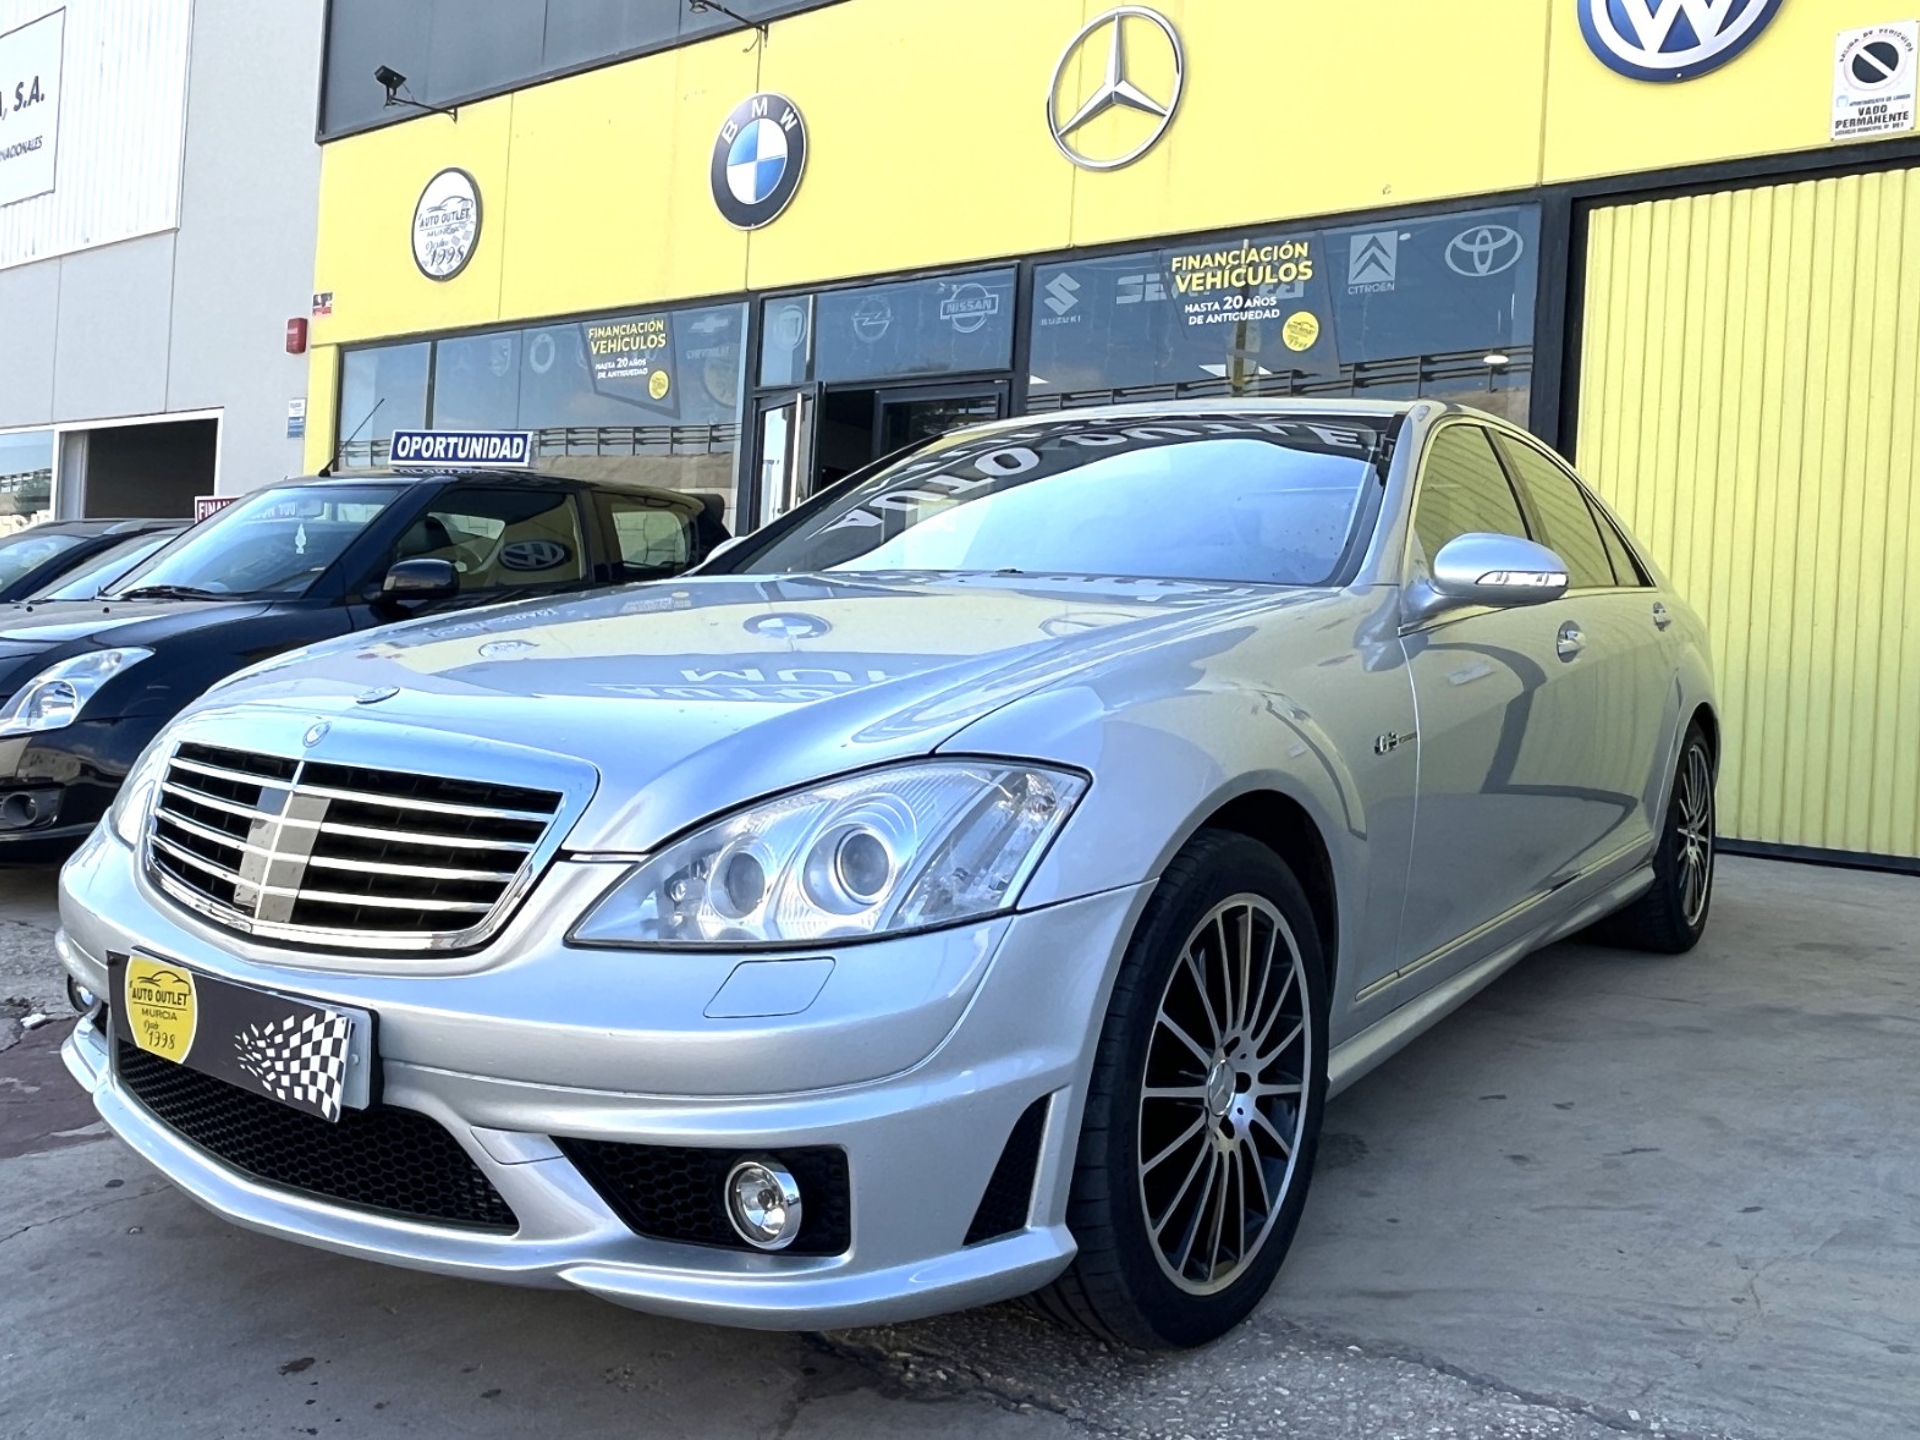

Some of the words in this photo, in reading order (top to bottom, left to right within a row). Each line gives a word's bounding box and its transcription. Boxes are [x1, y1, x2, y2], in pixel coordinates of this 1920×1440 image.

[13, 75, 45, 112] S.A.
[721, 97, 798, 145] BMW
[1835, 110, 1909, 129] PERMANENTE
[1857, 104, 1888, 117] VADO
[420, 213, 440, 228] AUTO
[441, 207, 471, 224] OUTLET
[430, 244, 465, 266] 1998
[1171, 241, 1309, 272] FINANCIACIÓN
[1174, 260, 1313, 293] VEHÍCULOS
[946, 299, 992, 314] NISSAN
[1184, 302, 1220, 314] HASTA
[1223, 295, 1242, 310] 20
[1244, 296, 1277, 308] AÑOS
[588, 318, 664, 339] FINANCIACIÓN
[1188, 315, 1203, 325] DE
[591, 333, 666, 354] VEHÍCULOS
[616, 357, 628, 368] 20
[397, 435, 525, 459] OPORTUNIDAD
[132, 986, 153, 1002] AUTO
[155, 989, 188, 1007] OUTLET
[141, 1006, 178, 1021] MURCIA
[148, 1030, 176, 1050] 1998
